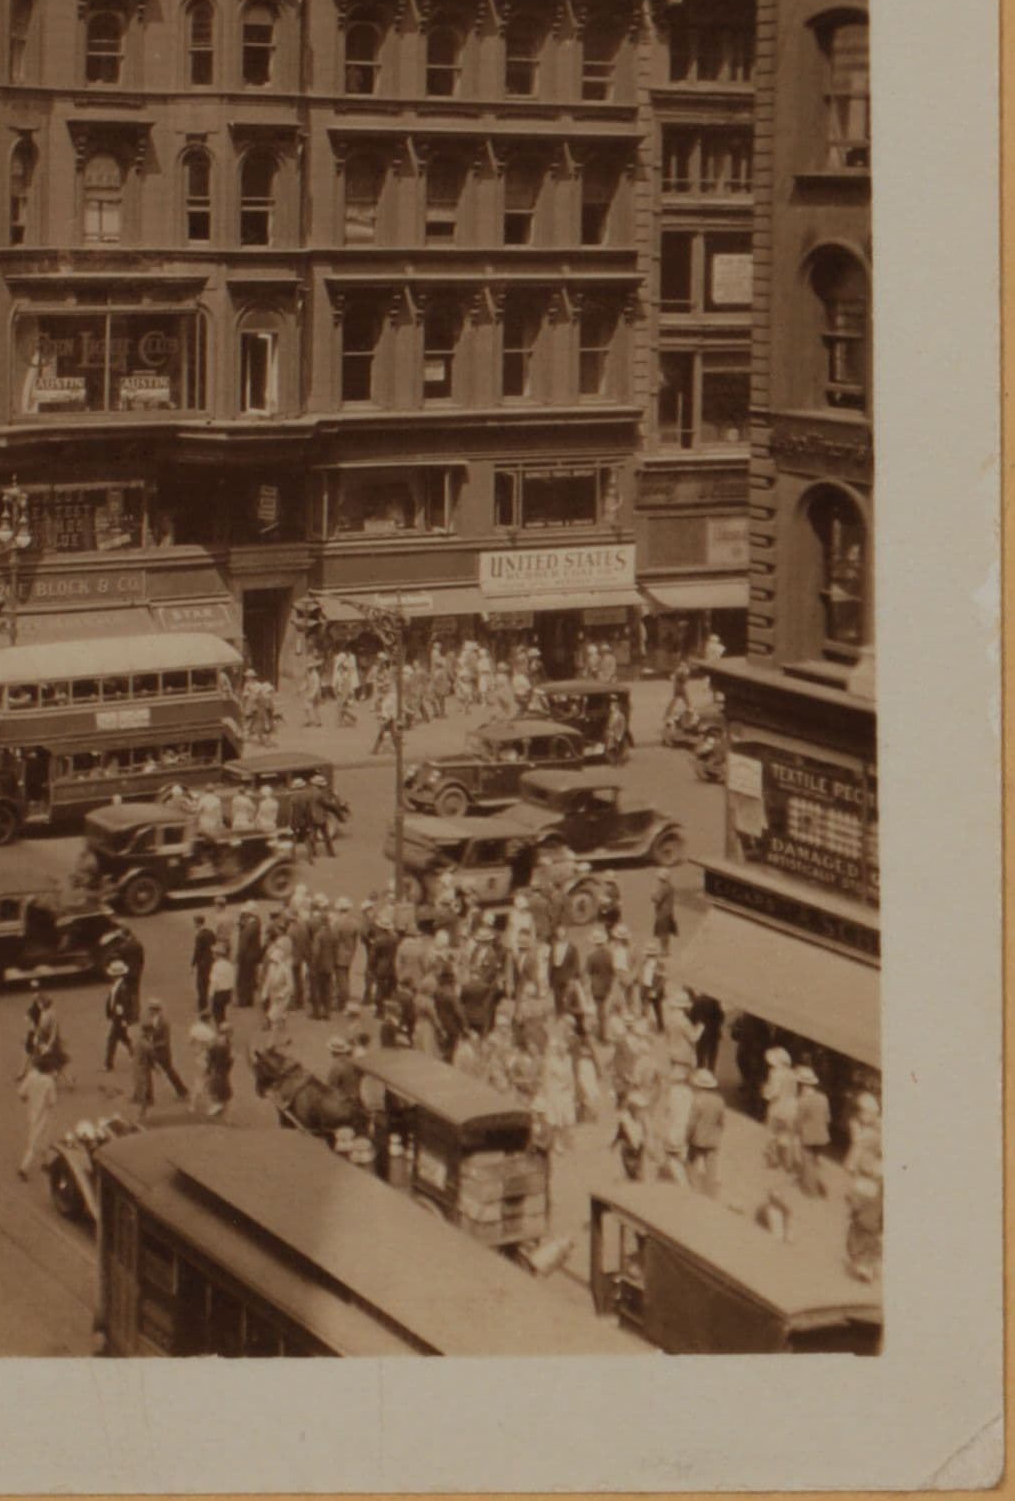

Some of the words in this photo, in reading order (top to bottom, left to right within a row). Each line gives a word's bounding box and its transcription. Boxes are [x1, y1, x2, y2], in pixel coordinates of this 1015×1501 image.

[36, 378, 84, 389] AUSTIN
[122, 377, 167, 388] AUSTIN
[491, 554, 559, 577] UNITED
[564, 549, 627, 572] STATES
[36, 579, 90, 597] BLOCK
[97, 578, 109, 593] &
[771, 763, 827, 793] TEXTILE
[770, 836, 859, 877] DAMAGED
